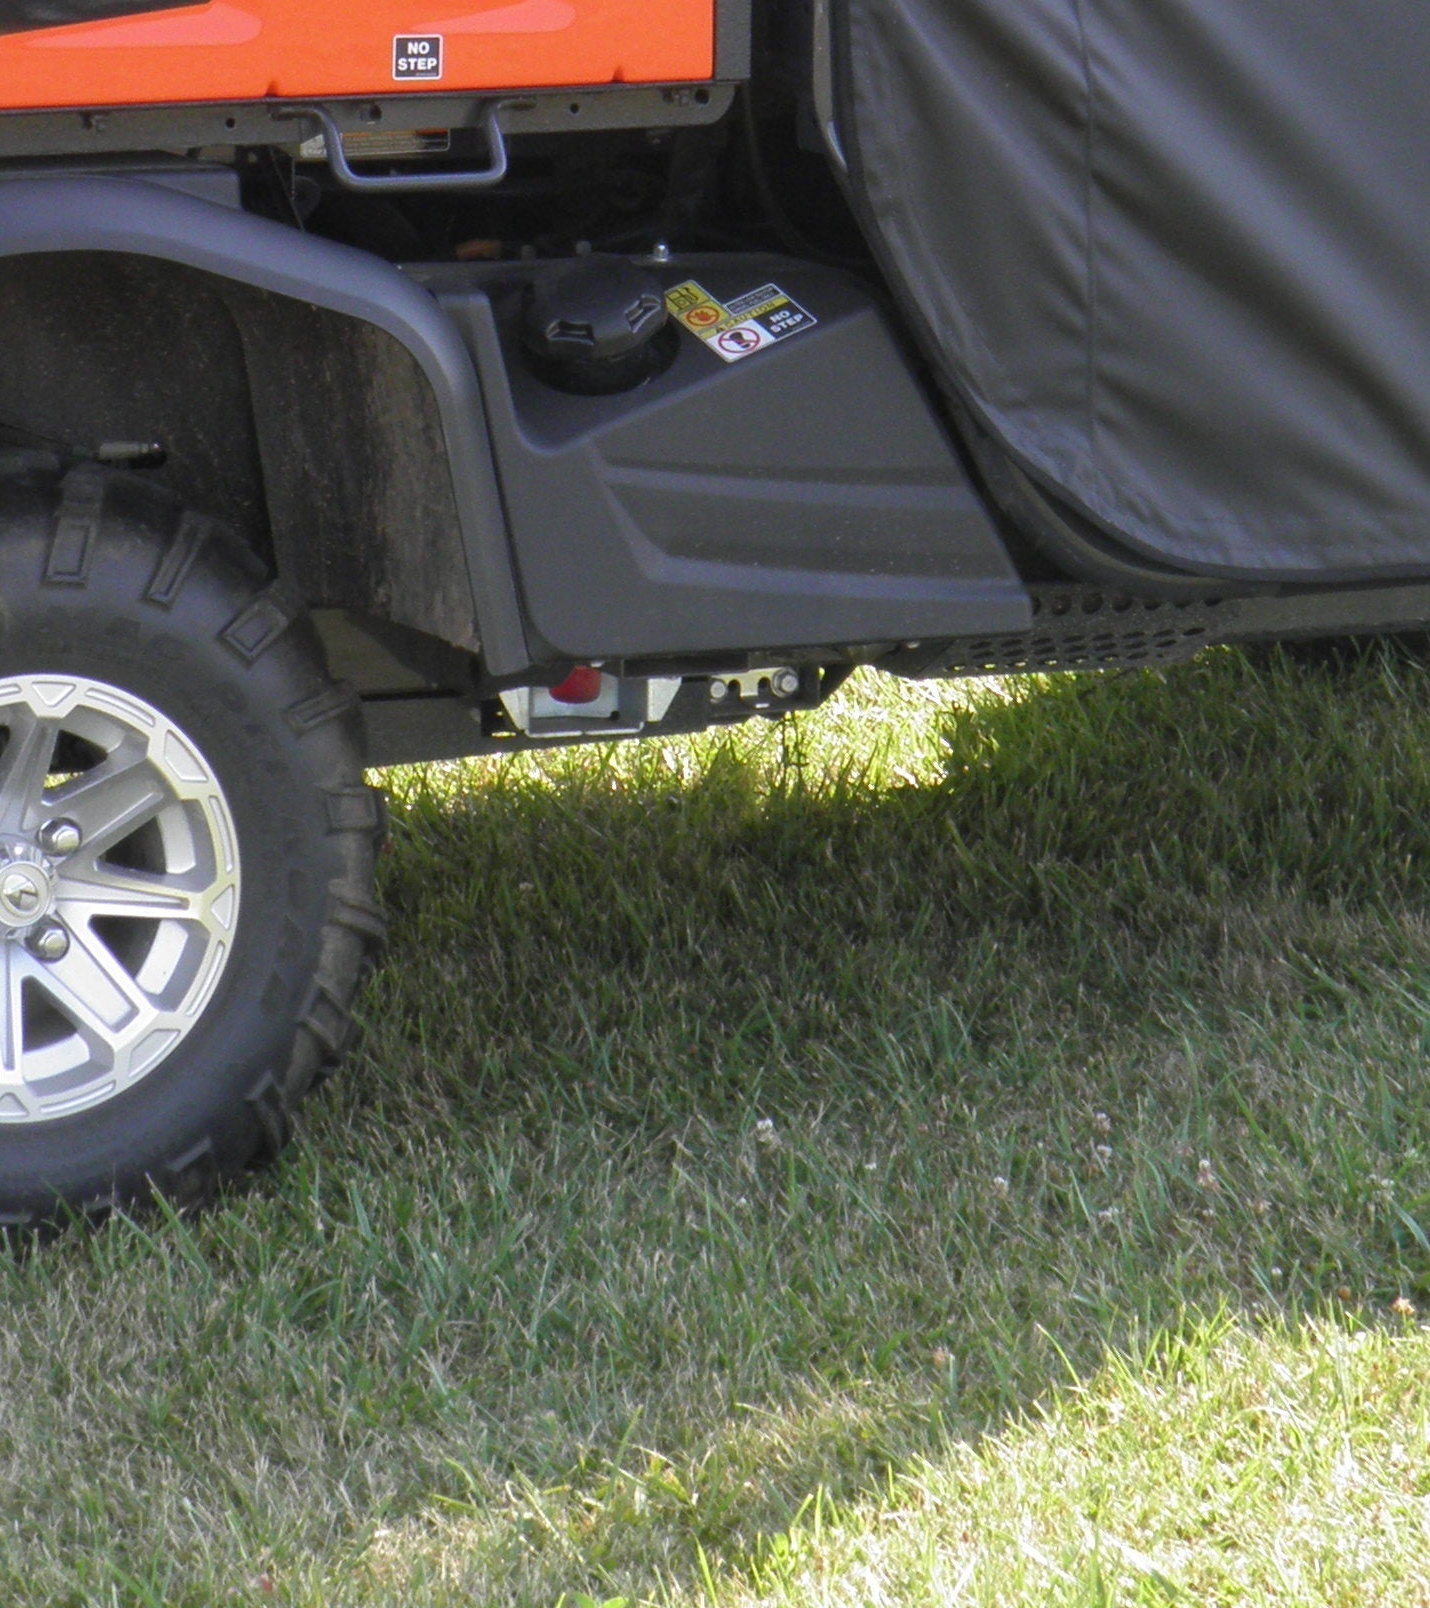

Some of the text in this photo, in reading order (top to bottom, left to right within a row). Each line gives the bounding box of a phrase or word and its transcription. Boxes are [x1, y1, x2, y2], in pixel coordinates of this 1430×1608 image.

[407, 41, 431, 55] NO
[397, 57, 438, 71] STEP
[769, 309, 791, 324] NO
[770, 313, 804, 333] STEP
